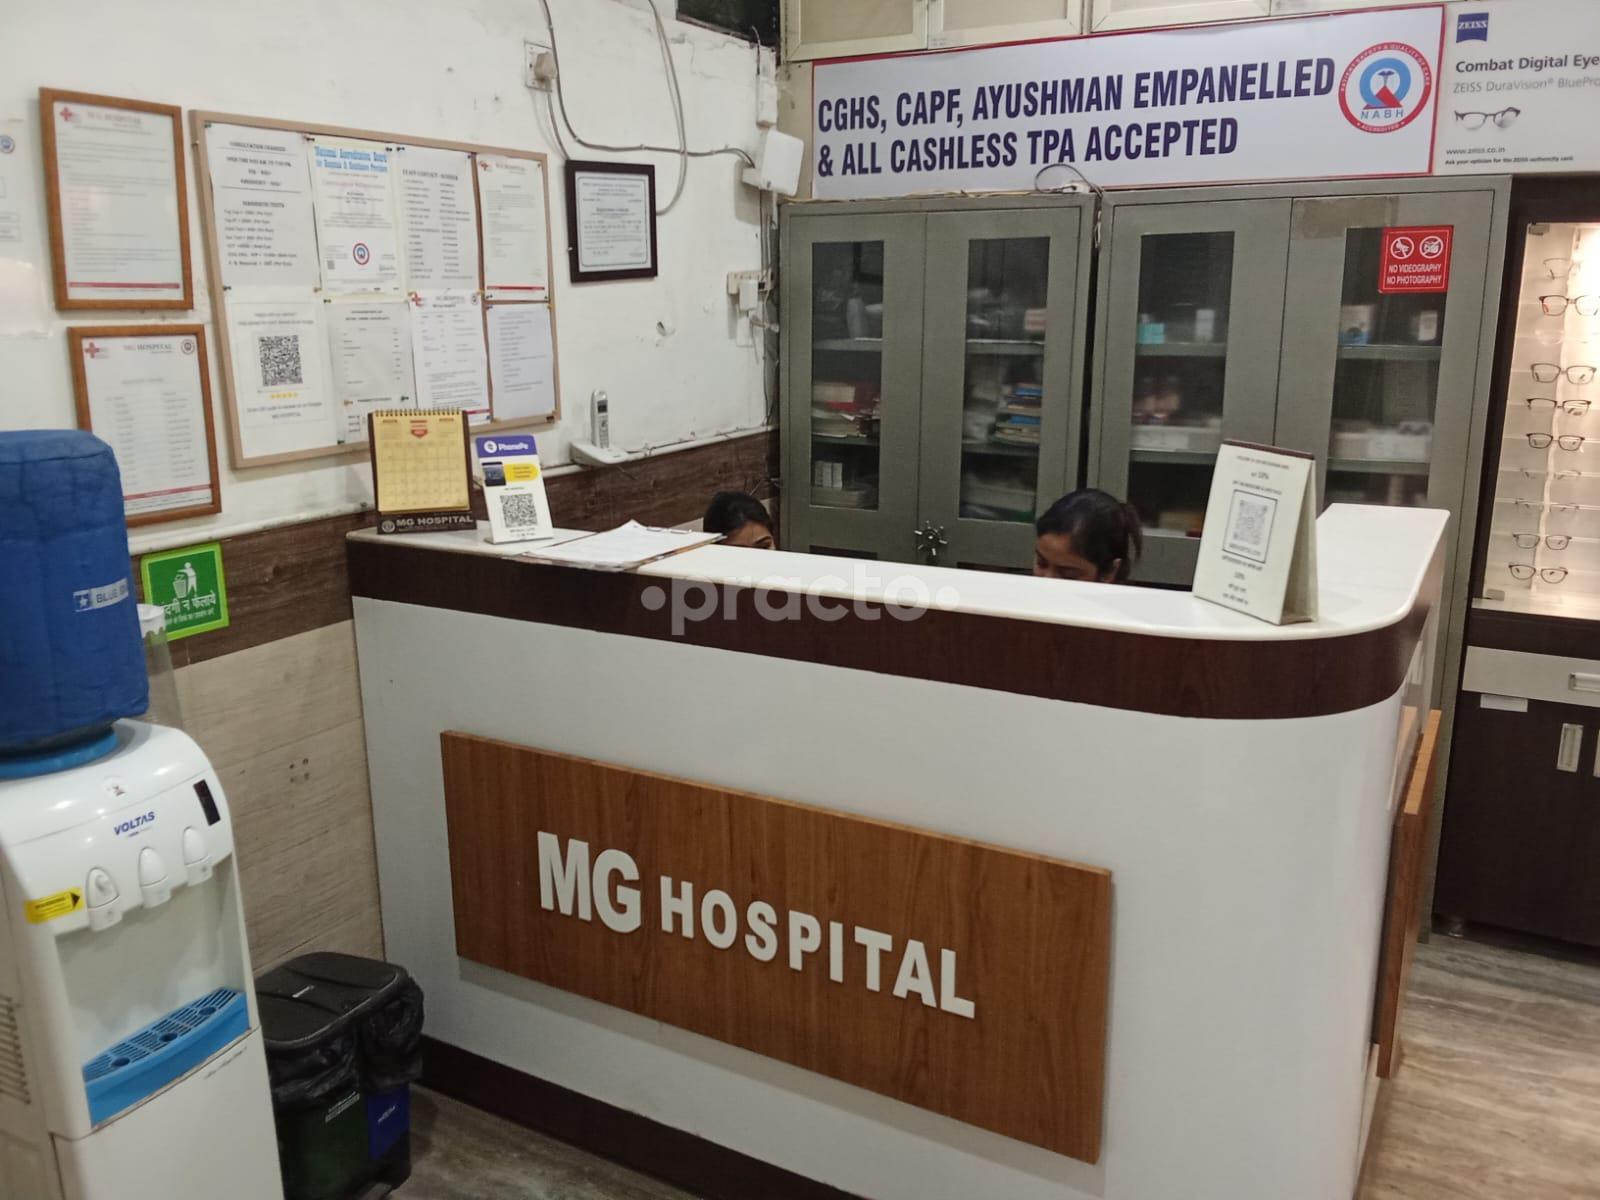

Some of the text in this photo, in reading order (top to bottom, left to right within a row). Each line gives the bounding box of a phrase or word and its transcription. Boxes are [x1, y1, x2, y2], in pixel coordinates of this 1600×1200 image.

[1458, 20, 1488, 30] ZEISS
[1455, 54, 1600, 73] Combat Digital Eye
[1453, 82, 1482, 94] ZEISS
[818, 57, 1335, 134] CGHS, CAPF, AYUSHMAN EMPANELLED
[1360, 109, 1404, 120] NABH
[818, 117, 1238, 177] & ALL CASHLESS TPA ACCEPTED
[1389, 263, 1442, 274] NO VIDEOGRAPHY
[1387, 275, 1442, 285] NO PHOTOGRAPHY
[498, 442, 529, 451] PhonePe
[396, 515, 473, 526] MG HOSPITAL
[96, 588, 118, 603] BLUE
[114, 811, 155, 835] VOLTAS
[536, 830, 976, 1020] MG HOSPITAL
